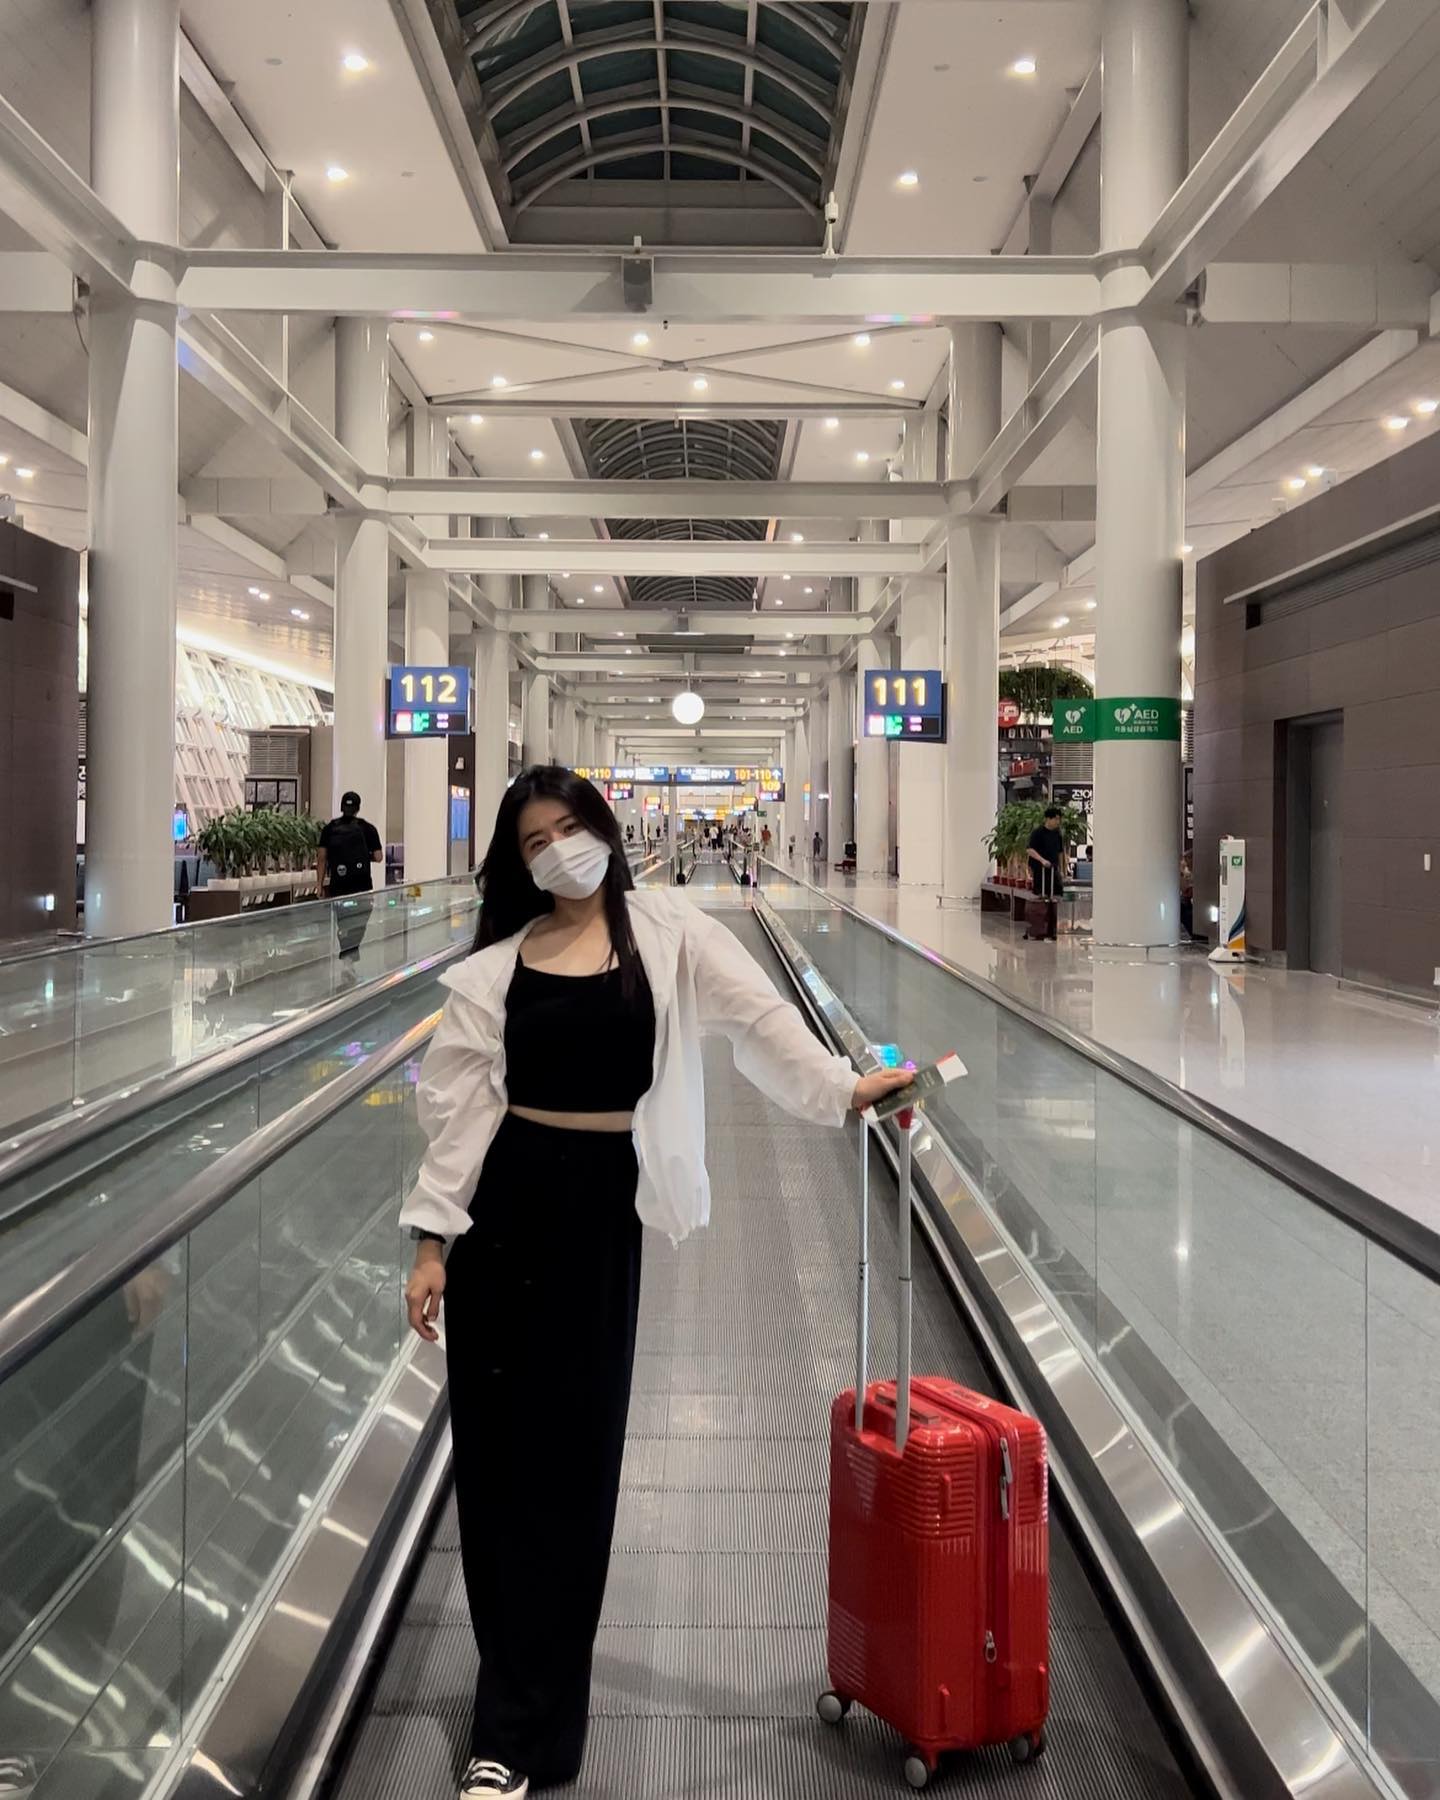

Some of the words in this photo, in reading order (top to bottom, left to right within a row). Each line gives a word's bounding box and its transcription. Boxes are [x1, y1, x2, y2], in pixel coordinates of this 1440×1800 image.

[400, 674, 457, 703] 112
[873, 677, 926, 706] 111
[1133, 709, 1159, 720] AED
[1063, 725, 1084, 734] AED
[735, 767, 772, 781] 101-110
